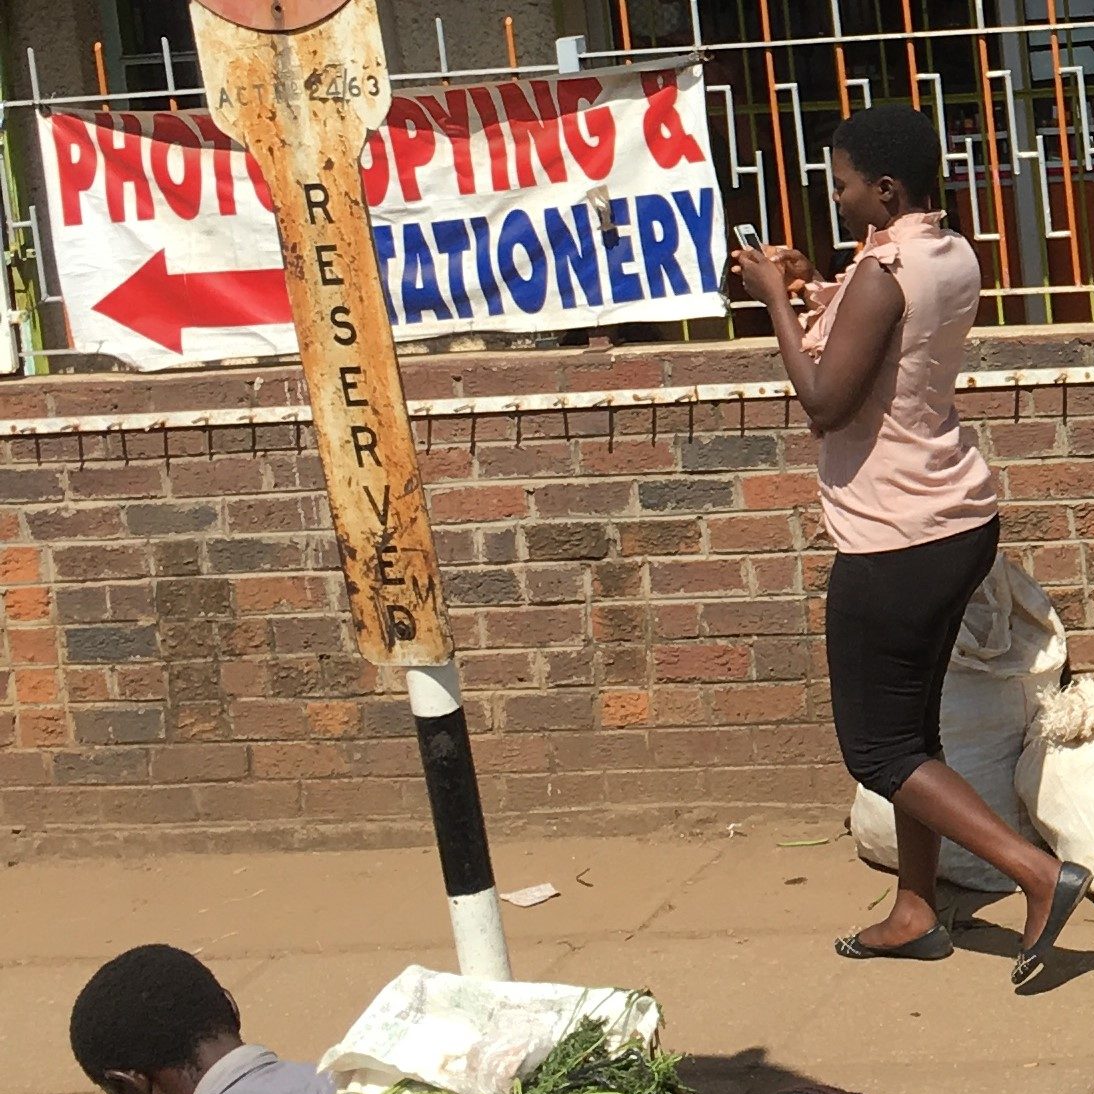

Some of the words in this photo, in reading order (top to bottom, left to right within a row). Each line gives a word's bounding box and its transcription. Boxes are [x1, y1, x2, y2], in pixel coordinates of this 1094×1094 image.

[641, 68, 706, 170] &
[372, 187, 719, 325] TATIONERY
[304, 183, 416, 643] RESERVED
